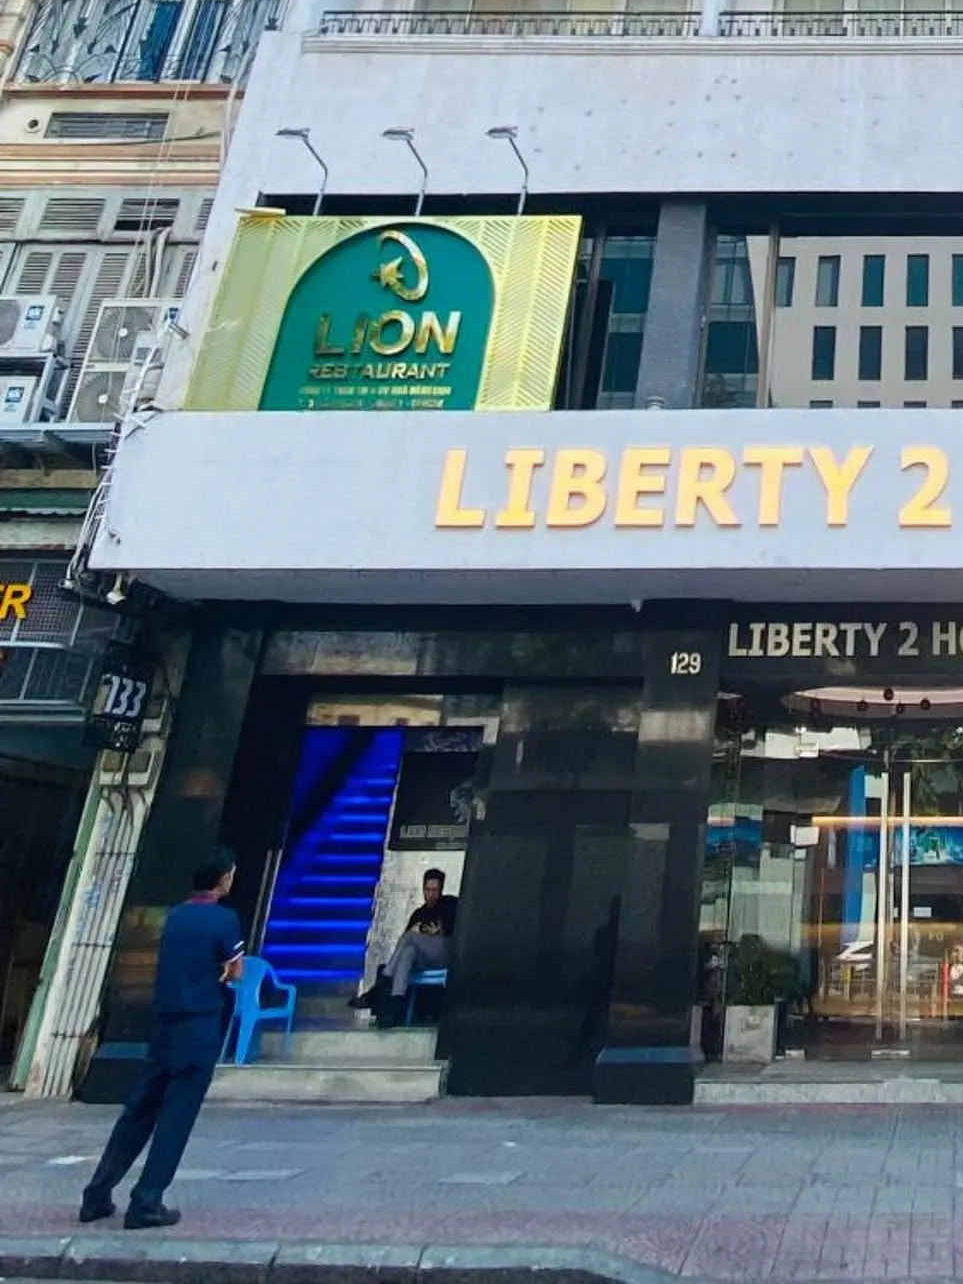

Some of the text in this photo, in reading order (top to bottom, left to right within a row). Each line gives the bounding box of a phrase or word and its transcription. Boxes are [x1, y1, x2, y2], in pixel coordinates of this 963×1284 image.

[314, 309, 462, 356] LION
[309, 362, 451, 380] RESTAURANT
[435, 445, 874, 528] LIBERTY
[899, 444, 951, 528] 2
[0, 583, 32, 620] R
[728, 622, 887, 657] LIBERTY
[899, 622, 919, 657] 2
[671, 652, 701, 674] 129
